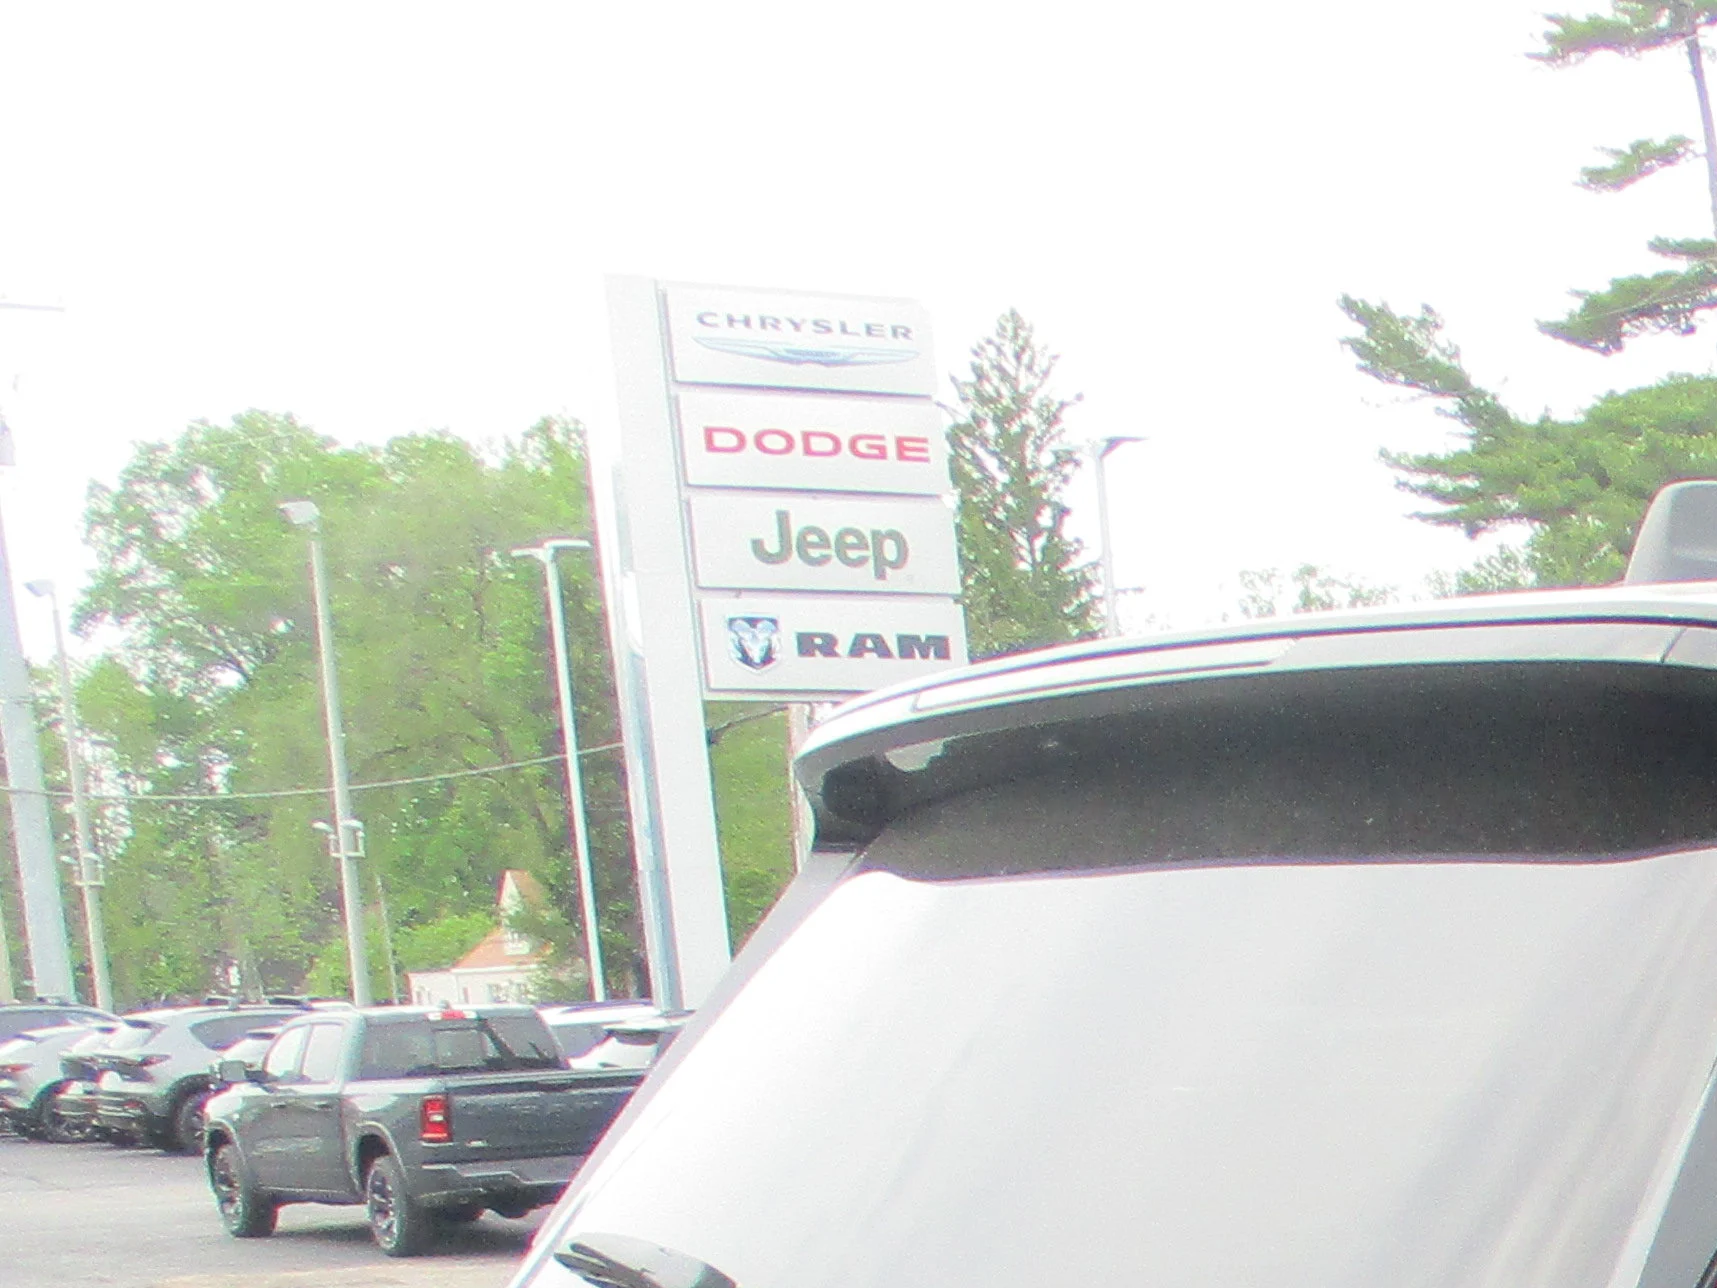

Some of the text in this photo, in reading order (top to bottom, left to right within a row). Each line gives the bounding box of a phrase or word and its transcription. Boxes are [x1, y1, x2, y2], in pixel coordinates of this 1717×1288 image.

[696, 311, 914, 341] CHRYSLER
[703, 426, 931, 463] DODGE
[750, 509, 909, 580] Jeep
[795, 631, 952, 660] RAM
